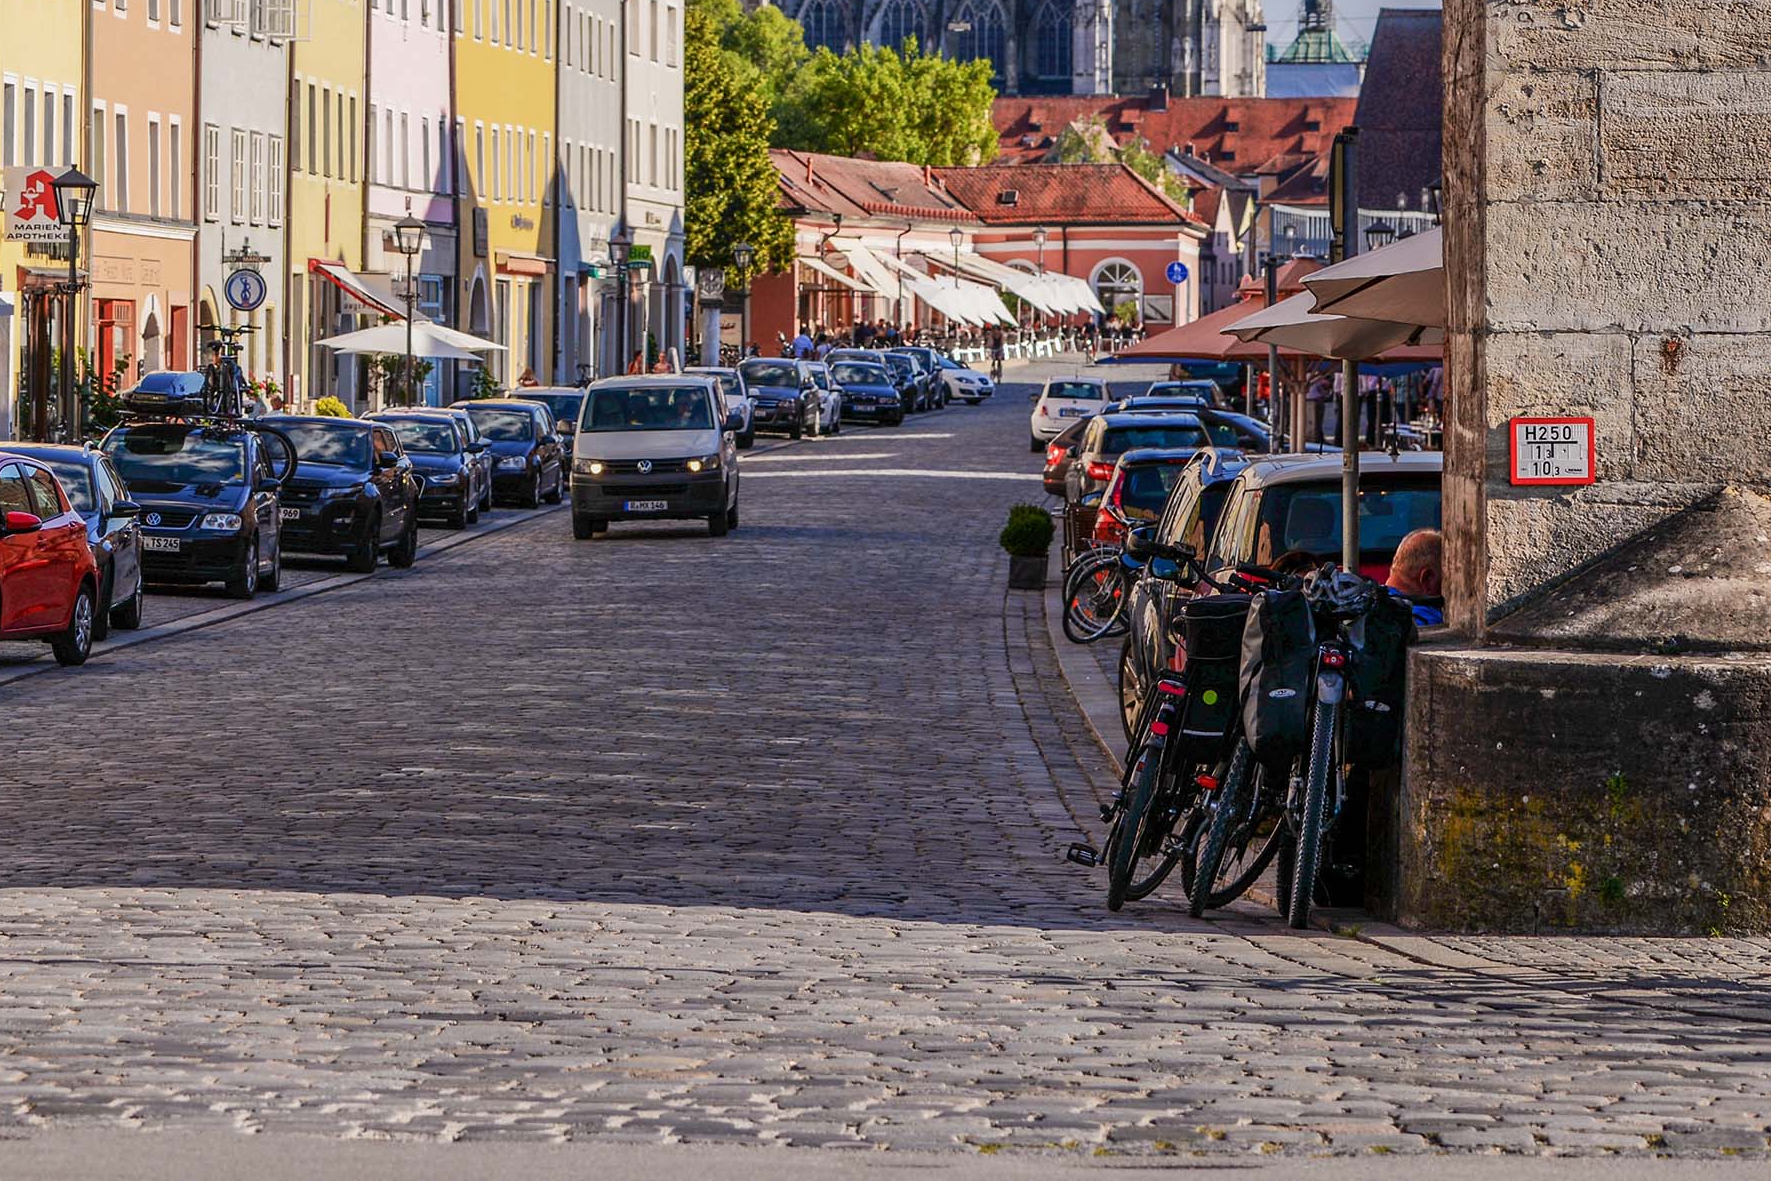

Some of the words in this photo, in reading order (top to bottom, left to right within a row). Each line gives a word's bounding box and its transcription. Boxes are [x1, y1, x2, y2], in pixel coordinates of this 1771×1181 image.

[14, 223, 62, 231] MARIEN
[6, 232, 70, 240] APOTHEKE
[1525, 425, 1572, 441] H250
[282, 509, 299, 518] 969
